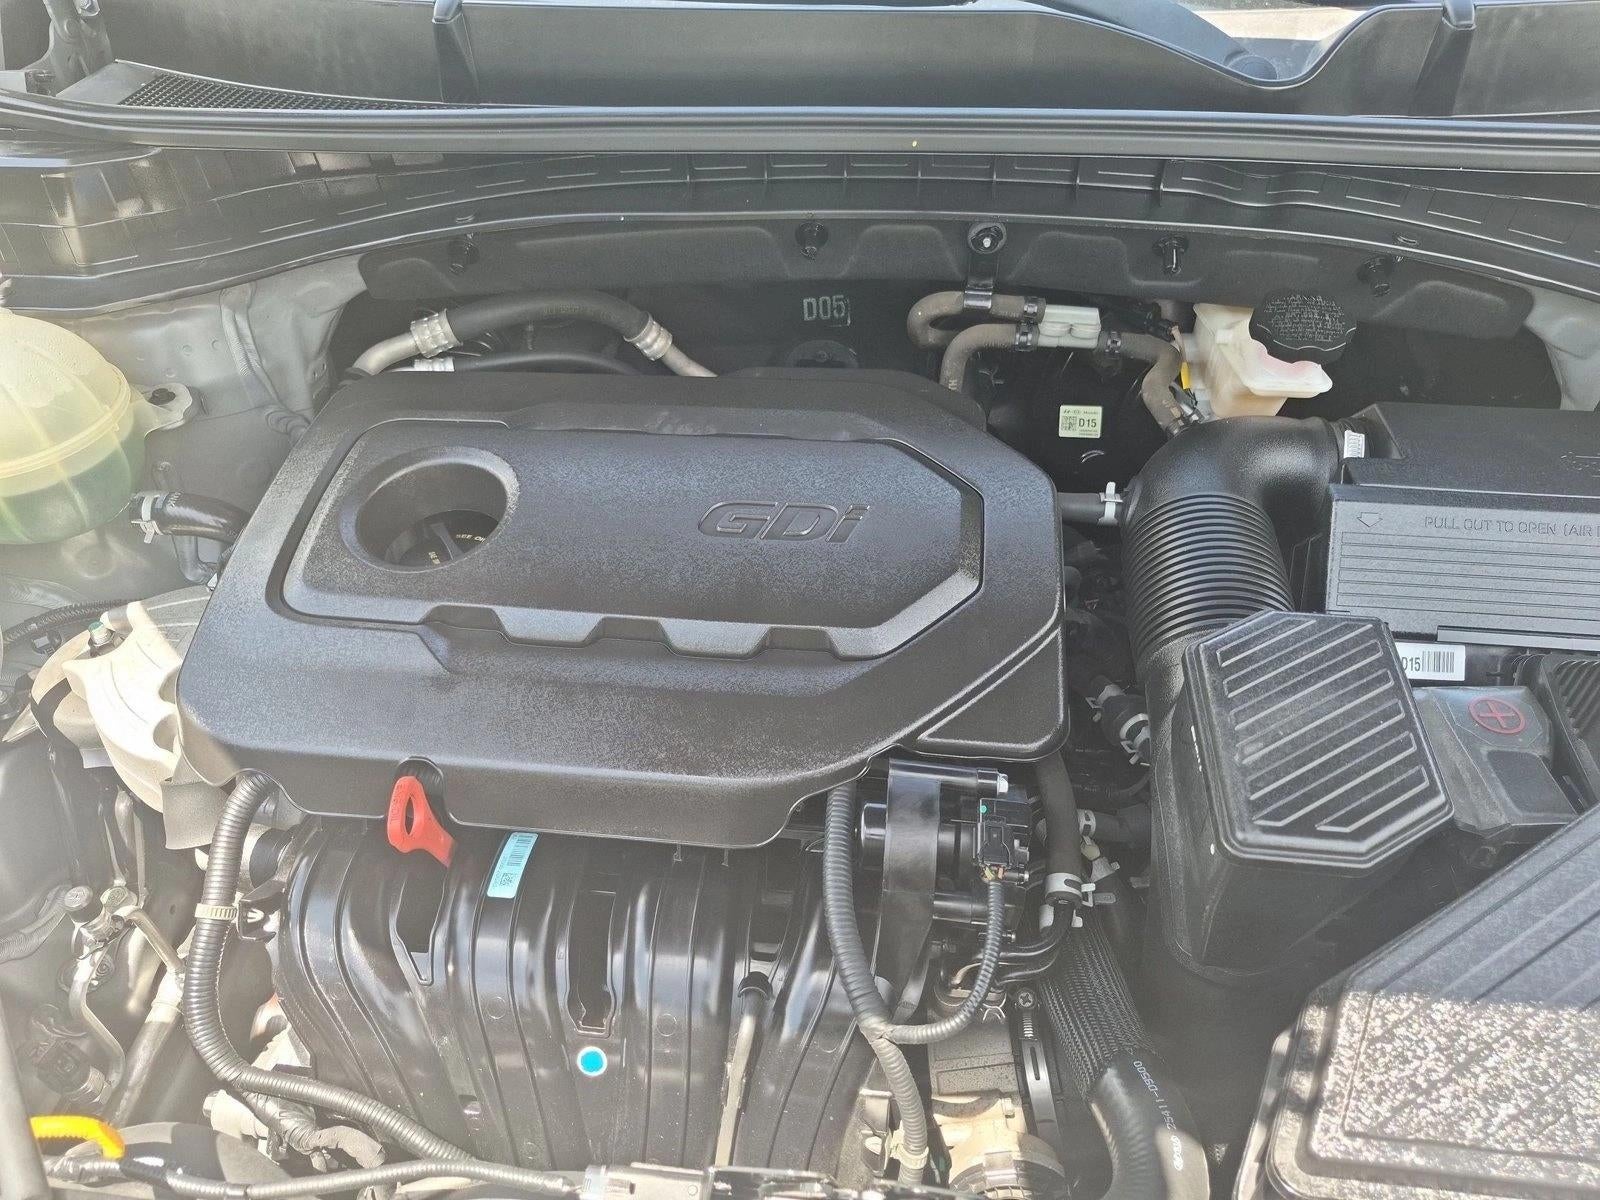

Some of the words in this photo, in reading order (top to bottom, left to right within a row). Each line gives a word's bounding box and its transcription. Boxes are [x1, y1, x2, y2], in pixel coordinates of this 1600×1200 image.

[1078, 418, 1097, 428] D15
[698, 500, 870, 543] GDi
[1424, 516, 1460, 530] PULL
[1463, 518, 1492, 531] OUT
[1496, 520, 1514, 533] TO
[1518, 521, 1557, 535] OPEN
[1563, 523, 1592, 537] (AIR
[1133, 1060, 1177, 1130] 25411-D9500
